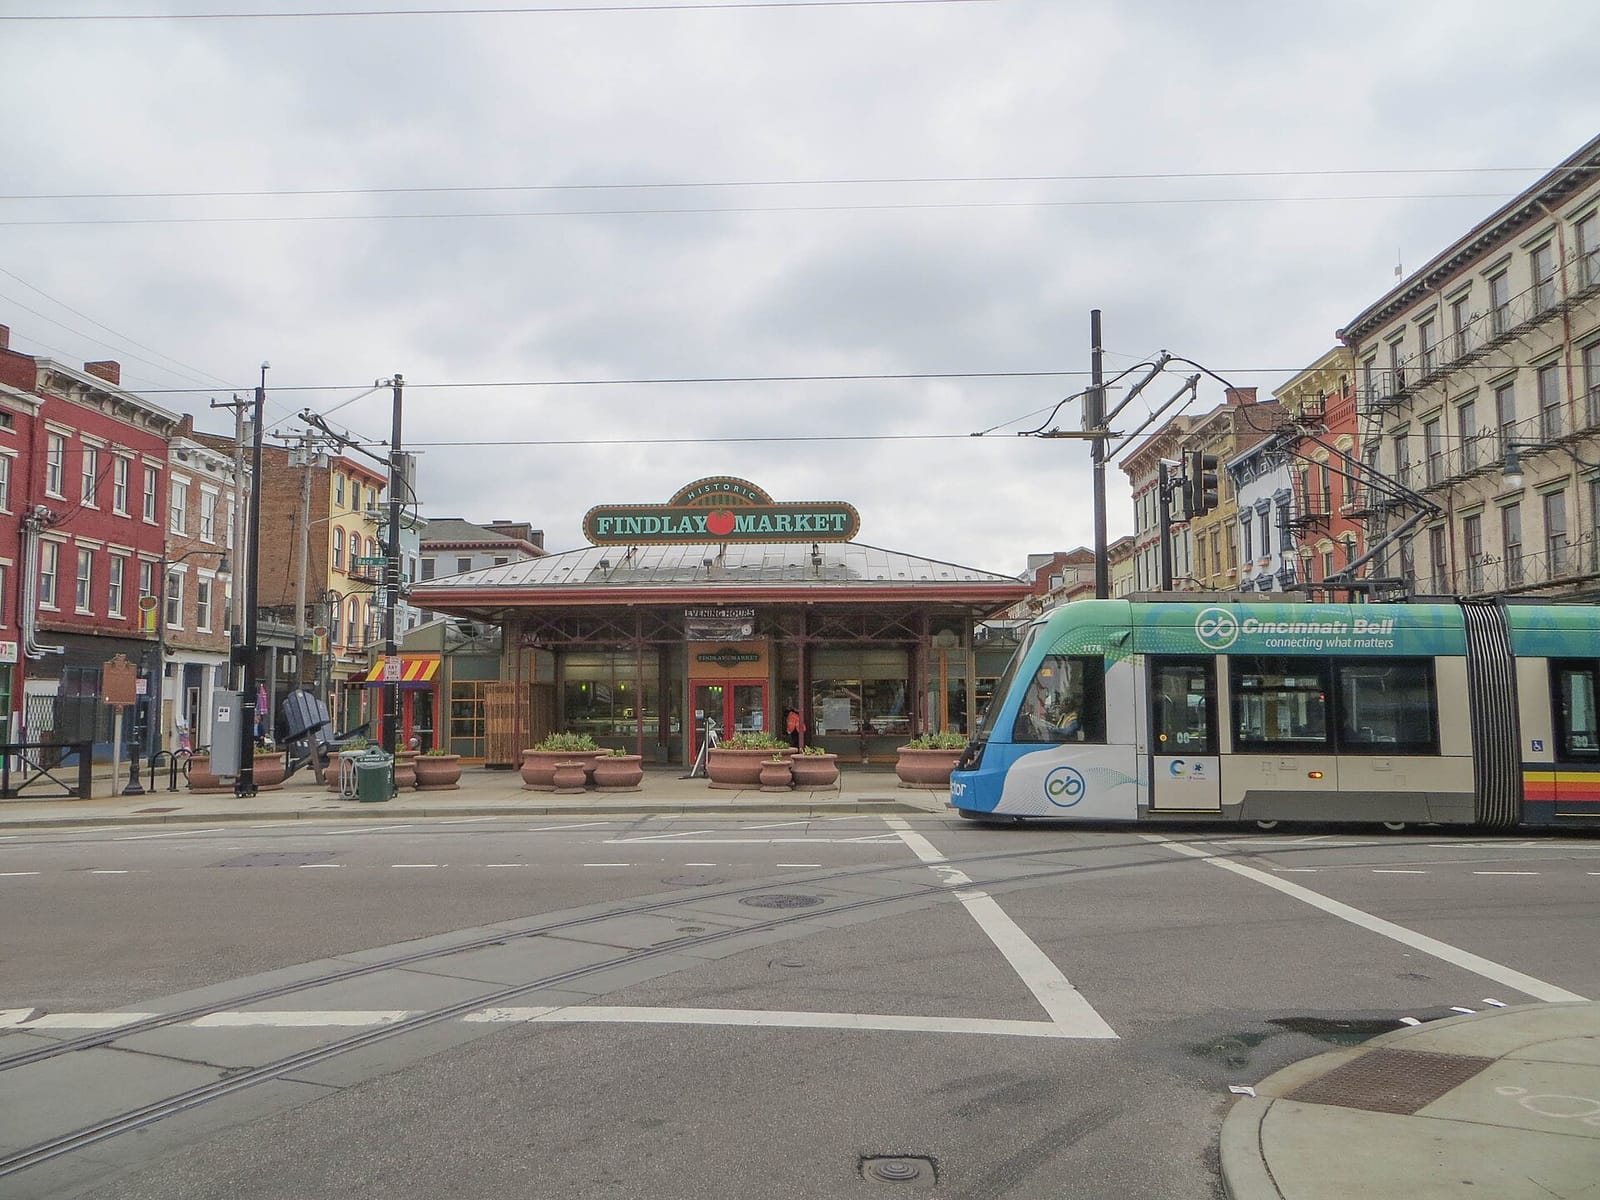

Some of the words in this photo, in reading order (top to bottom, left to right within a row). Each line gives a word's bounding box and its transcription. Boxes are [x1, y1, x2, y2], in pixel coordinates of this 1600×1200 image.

[688, 484, 756, 500] HISTORIC
[597, 516, 708, 534] FINDLAY
[733, 514, 846, 532] MARKET
[1242, 618, 1348, 634] Cincinnati
[1352, 619, 1394, 634] Bell
[1266, 638, 1322, 650] connecting
[1326, 636, 1350, 648] what
[1354, 638, 1394, 648] matters
